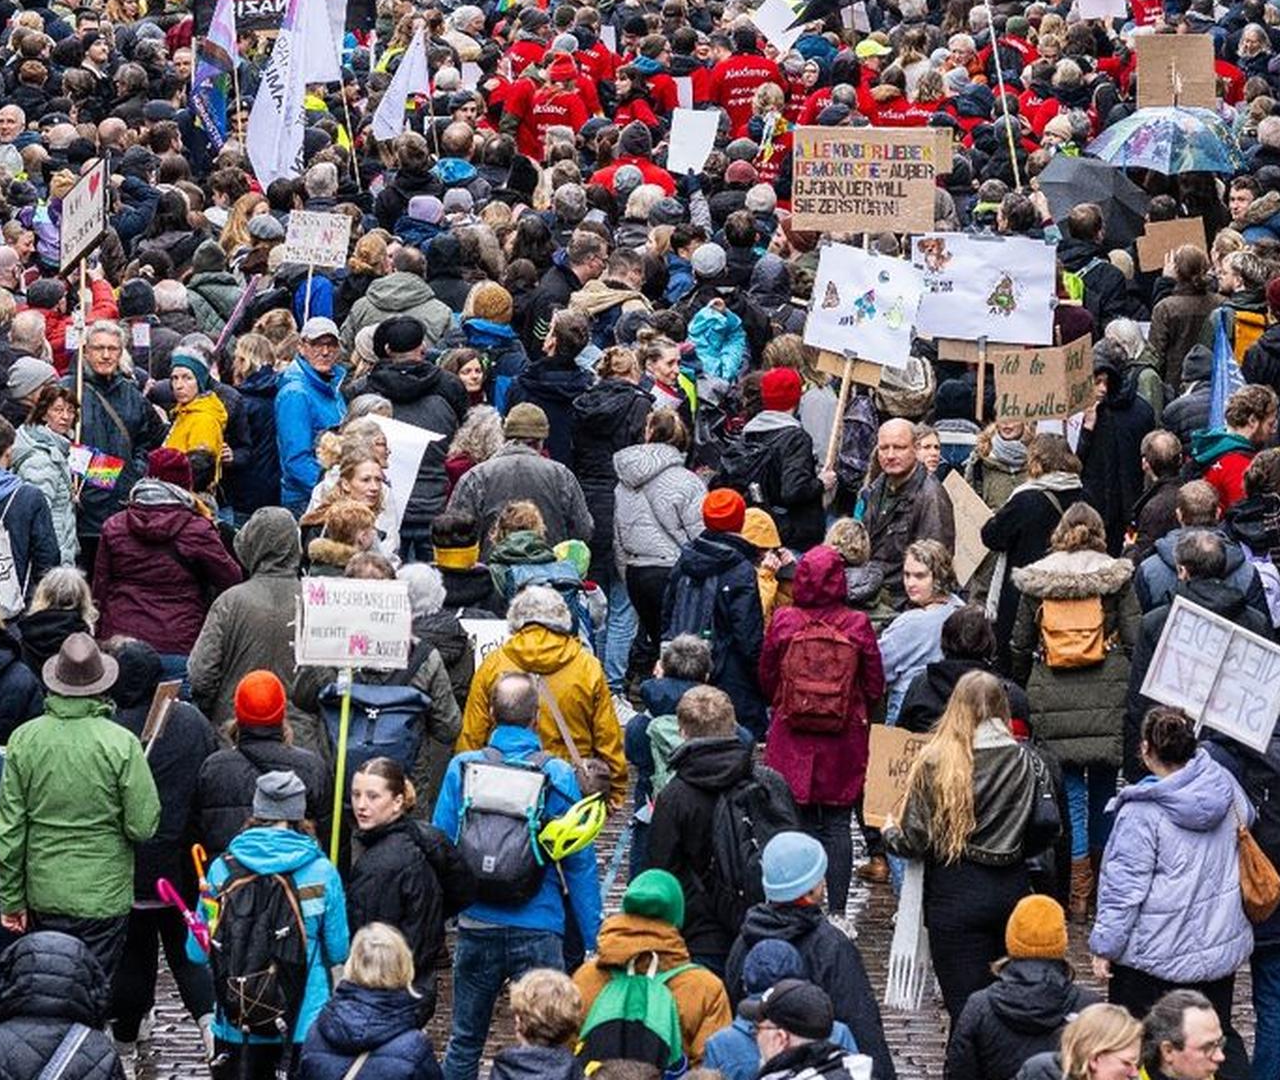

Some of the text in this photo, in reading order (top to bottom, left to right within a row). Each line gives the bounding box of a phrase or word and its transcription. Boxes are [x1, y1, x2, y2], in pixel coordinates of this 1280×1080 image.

[795, 136, 832, 160] ALLE
[883, 142, 934, 161] LIEBEN
[794, 199, 816, 214] SIE
